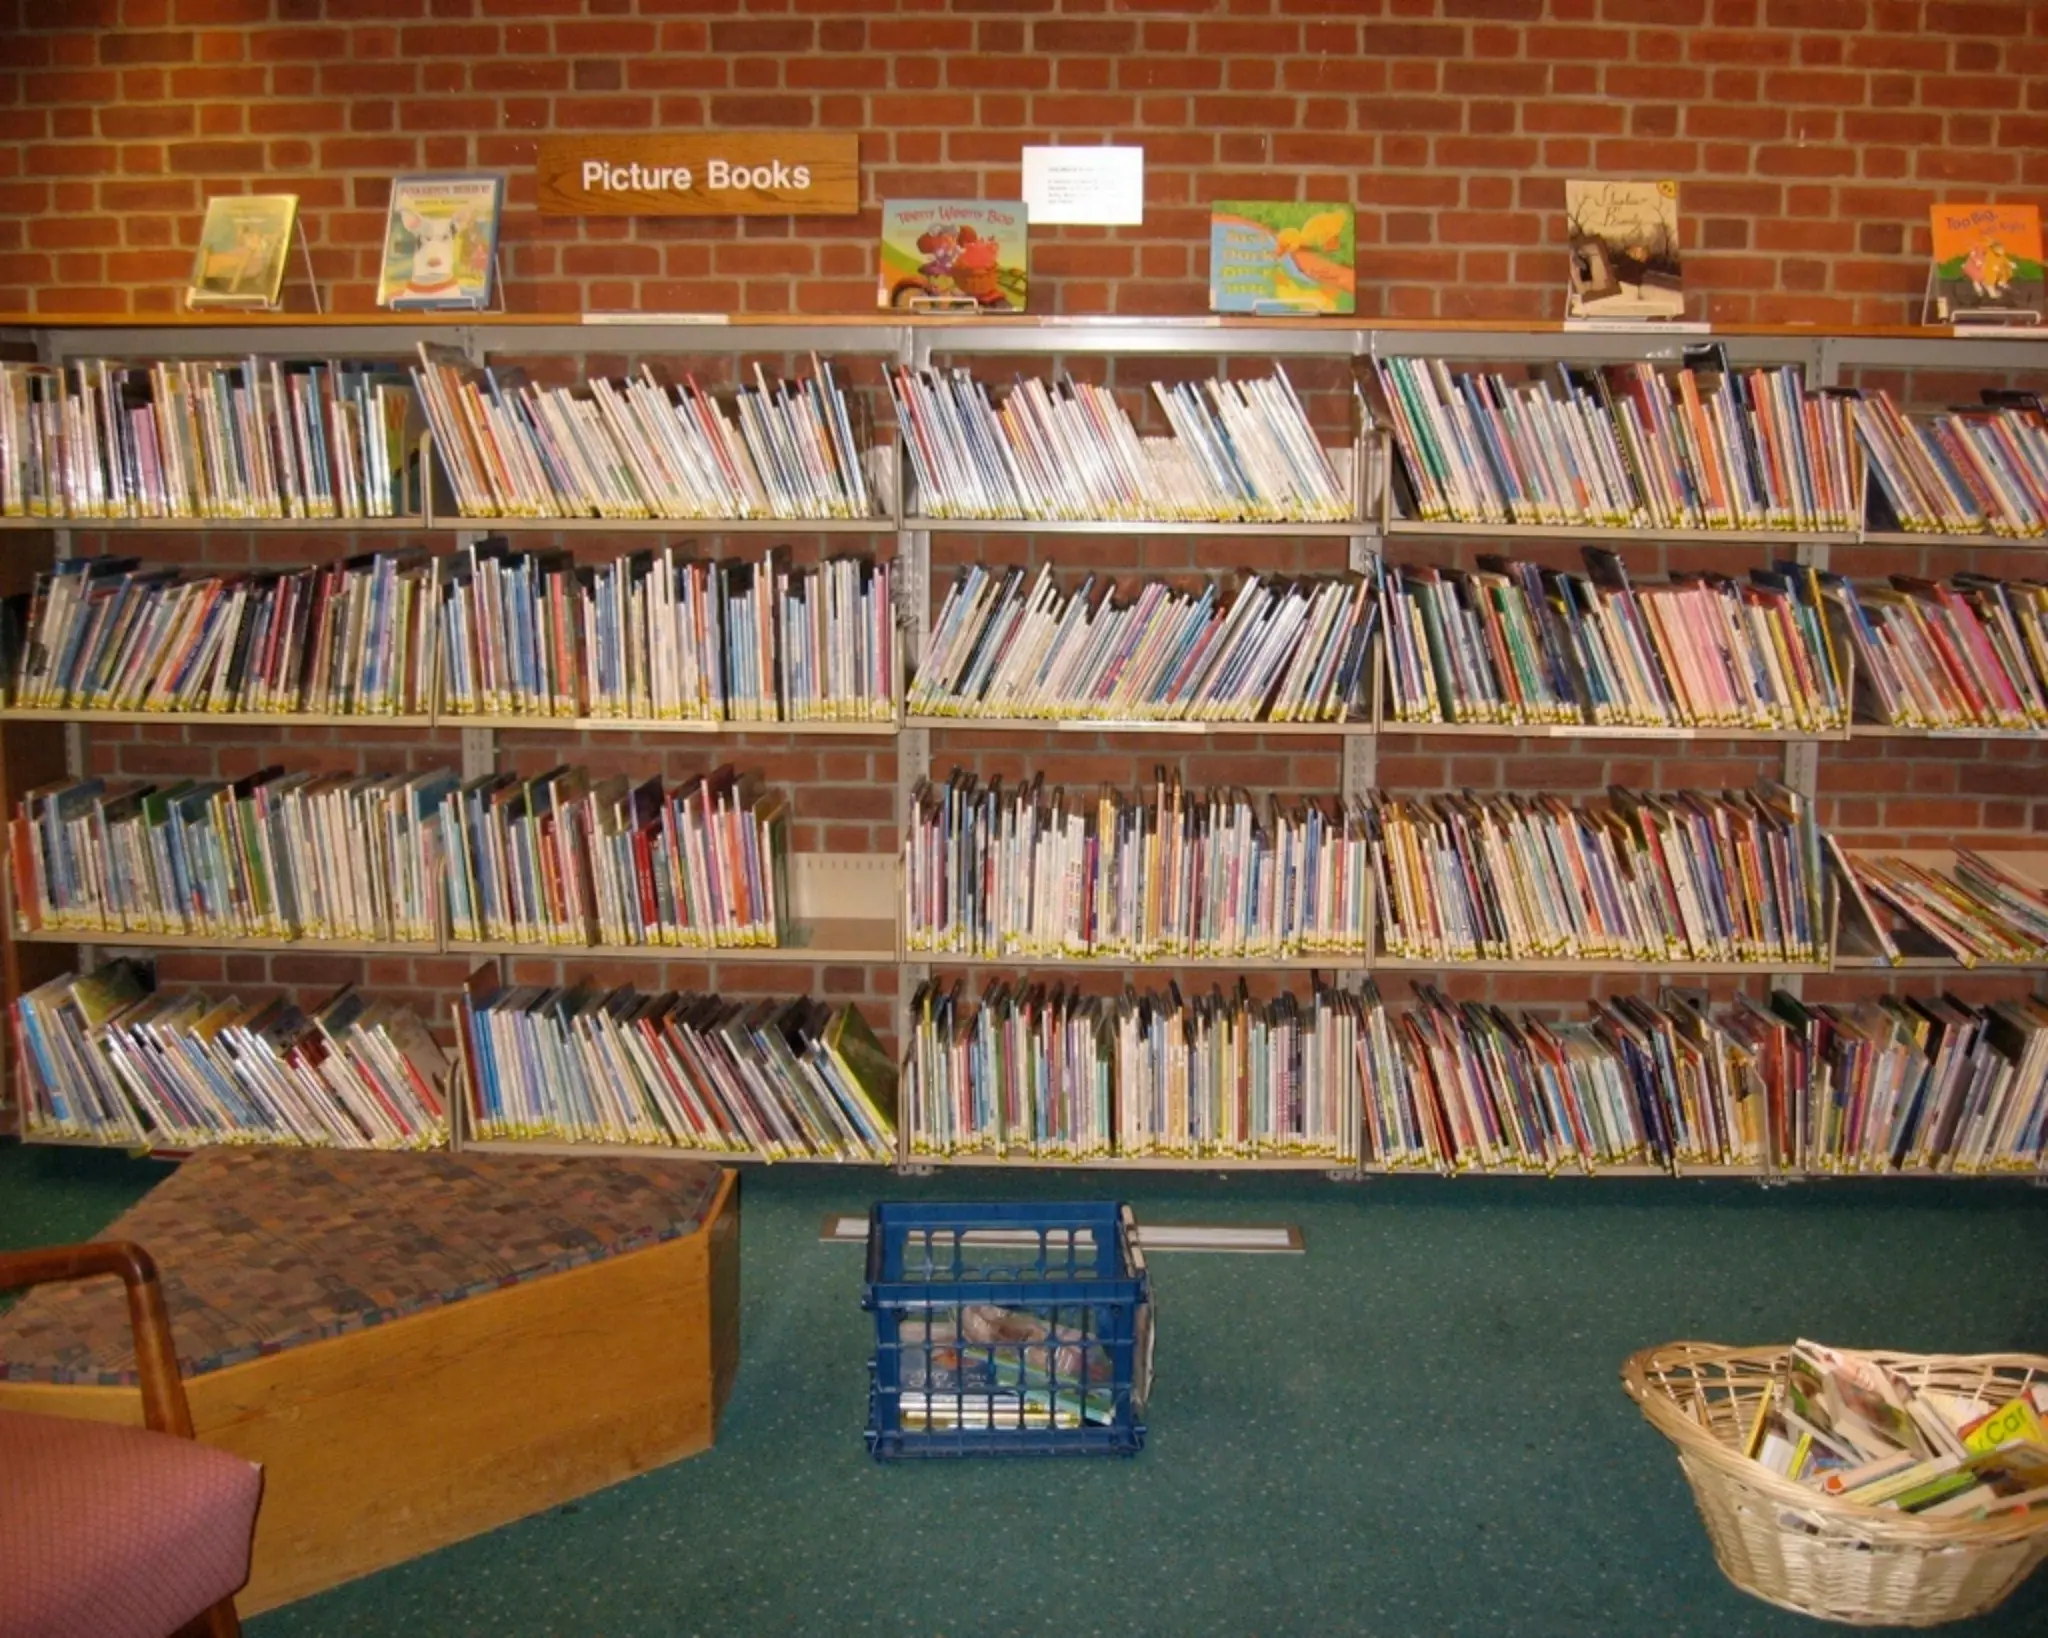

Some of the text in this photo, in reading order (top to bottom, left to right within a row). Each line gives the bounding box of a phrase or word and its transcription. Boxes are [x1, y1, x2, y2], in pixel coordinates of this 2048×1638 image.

[582, 159, 811, 191] Picture Books
[1986, 1406, 2027, 1445] Car
